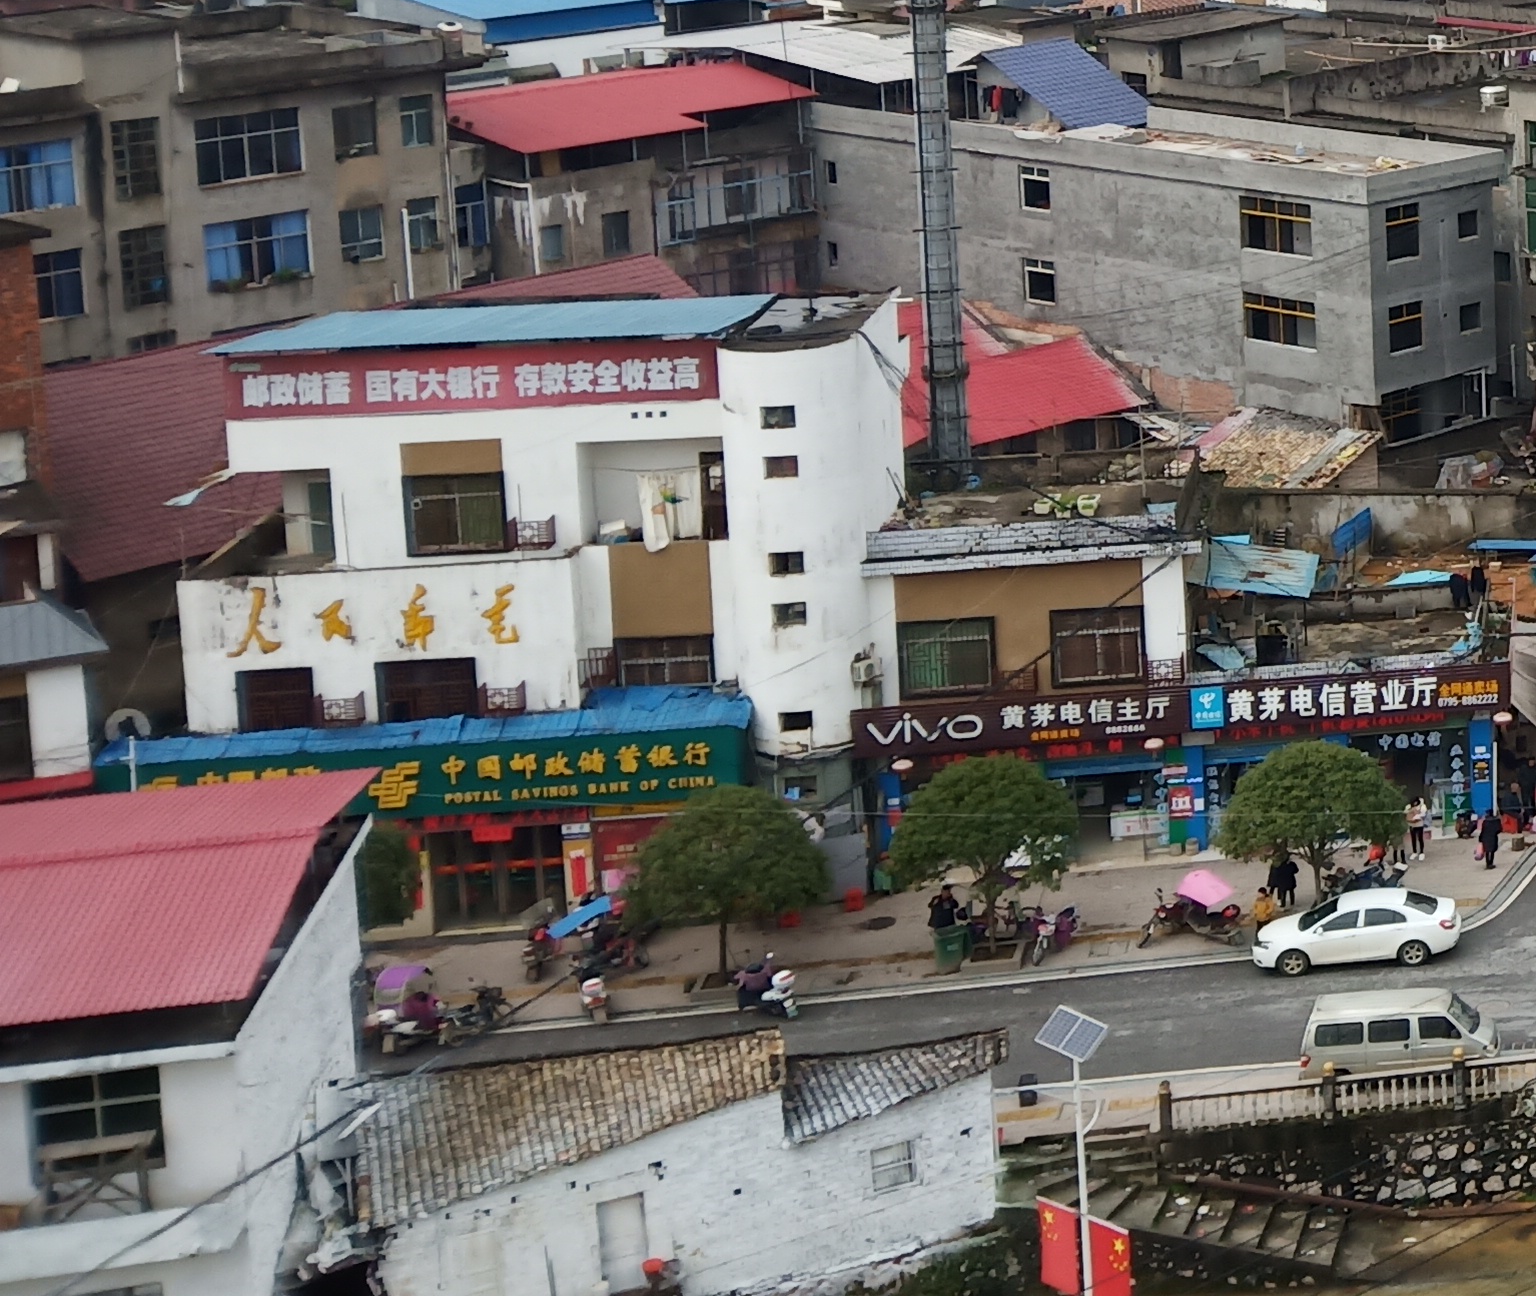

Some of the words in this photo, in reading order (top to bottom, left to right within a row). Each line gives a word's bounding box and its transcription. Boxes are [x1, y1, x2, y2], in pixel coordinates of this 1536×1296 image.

[243, 371, 351, 407] 邮政储蓄
[365, 365, 500, 402] 国有大银行
[514, 357, 700, 397] 存款安全收益高
[1000, 696, 1170, 730] 黄茅电信主厅
[1227, 676, 1438, 722] 黄茅电信营业厅
[866, 712, 983, 745] vivo
[441, 742, 711, 785] 中国邮政储蓄银行
[587, 780, 630, 796] BANK
[639, 778, 659, 791] OF
